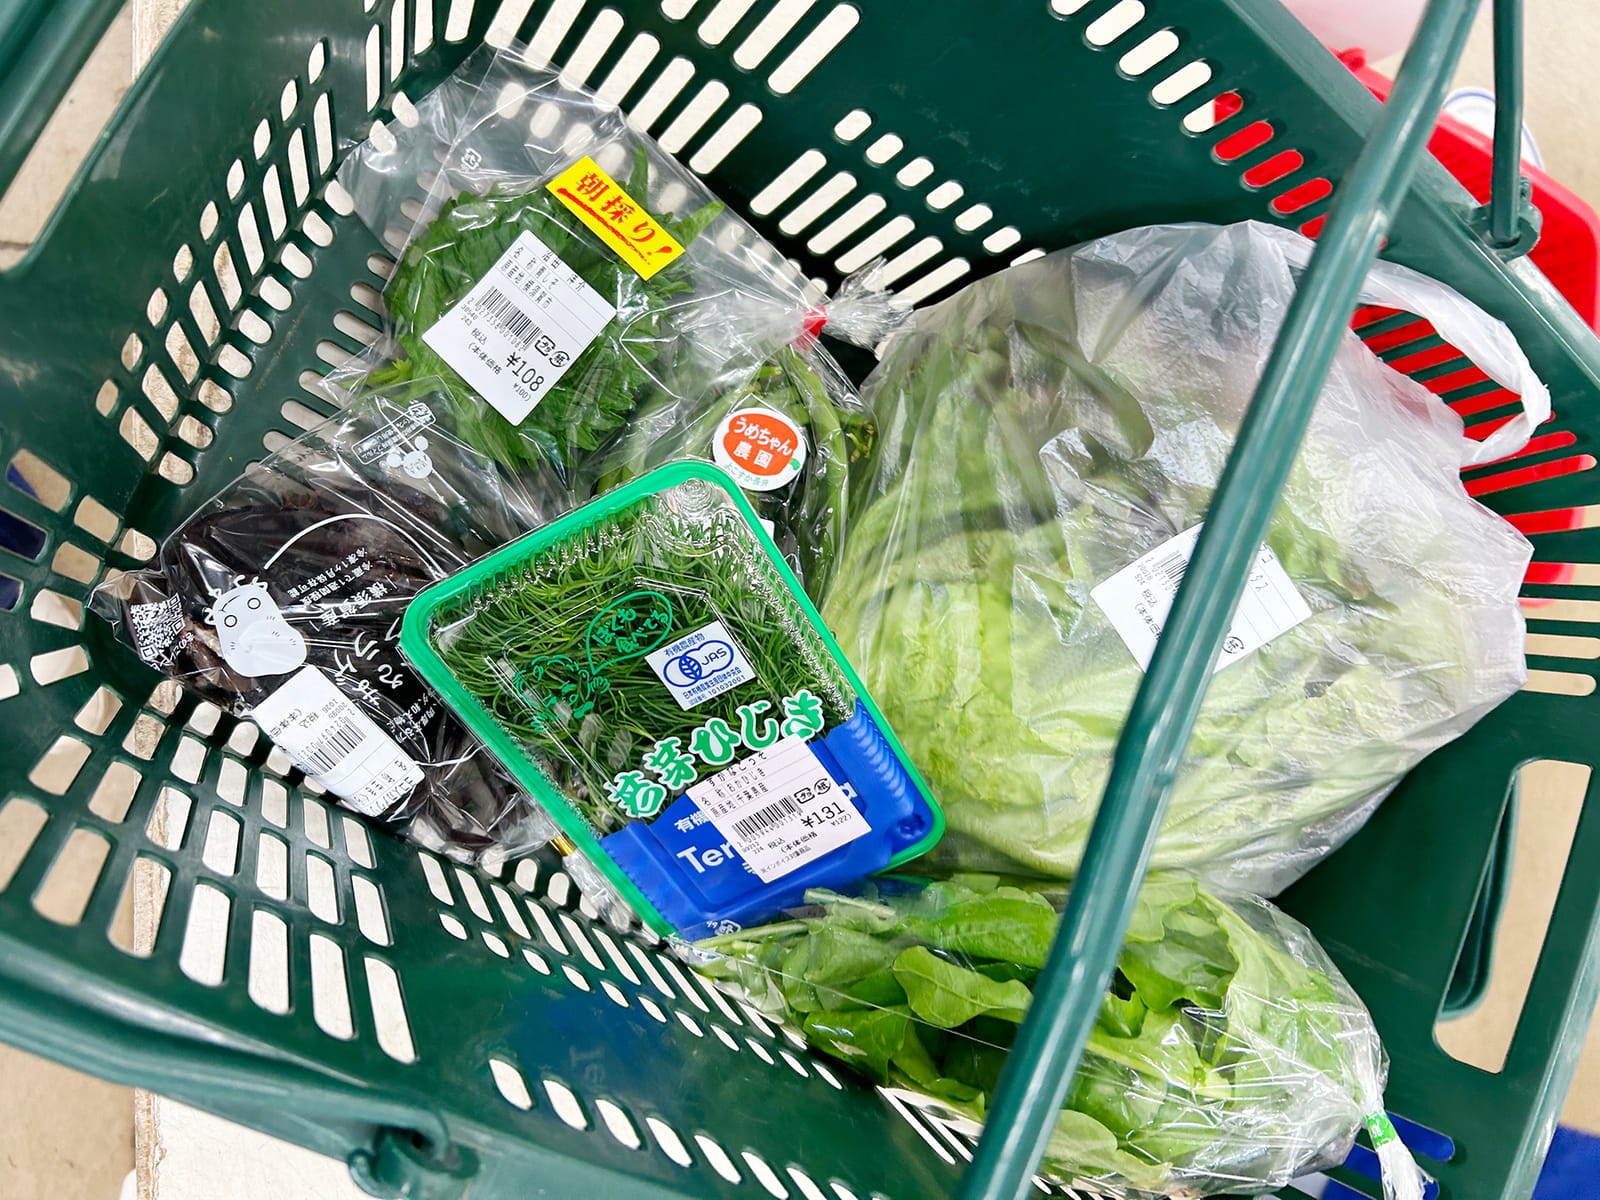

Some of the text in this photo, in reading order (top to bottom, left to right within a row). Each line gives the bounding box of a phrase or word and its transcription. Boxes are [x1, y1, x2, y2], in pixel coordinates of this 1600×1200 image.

[576, 172, 673, 255] 朝採り!
[465, 341, 503, 376] (本体価格
[469, 326, 546, 394] 税込 ¥108
[733, 415, 792, 456] うめちゃん
[732, 439, 774, 469] 農園
[1140, 587, 1159, 609] 税込
[591, 606, 637, 647] ぼくも
[614, 609, 668, 653] 食べてる
[663, 631, 705, 657] 有機農産物
[701, 646, 728, 665] JAS
[298, 710, 319, 729] 税込
[726, 766, 766, 793] おかひじき
[767, 835, 786, 850] 税込
[799, 799, 846, 830] ¥131
[779, 829, 818, 853] (本体価格
[676, 841, 739, 874] Ter
